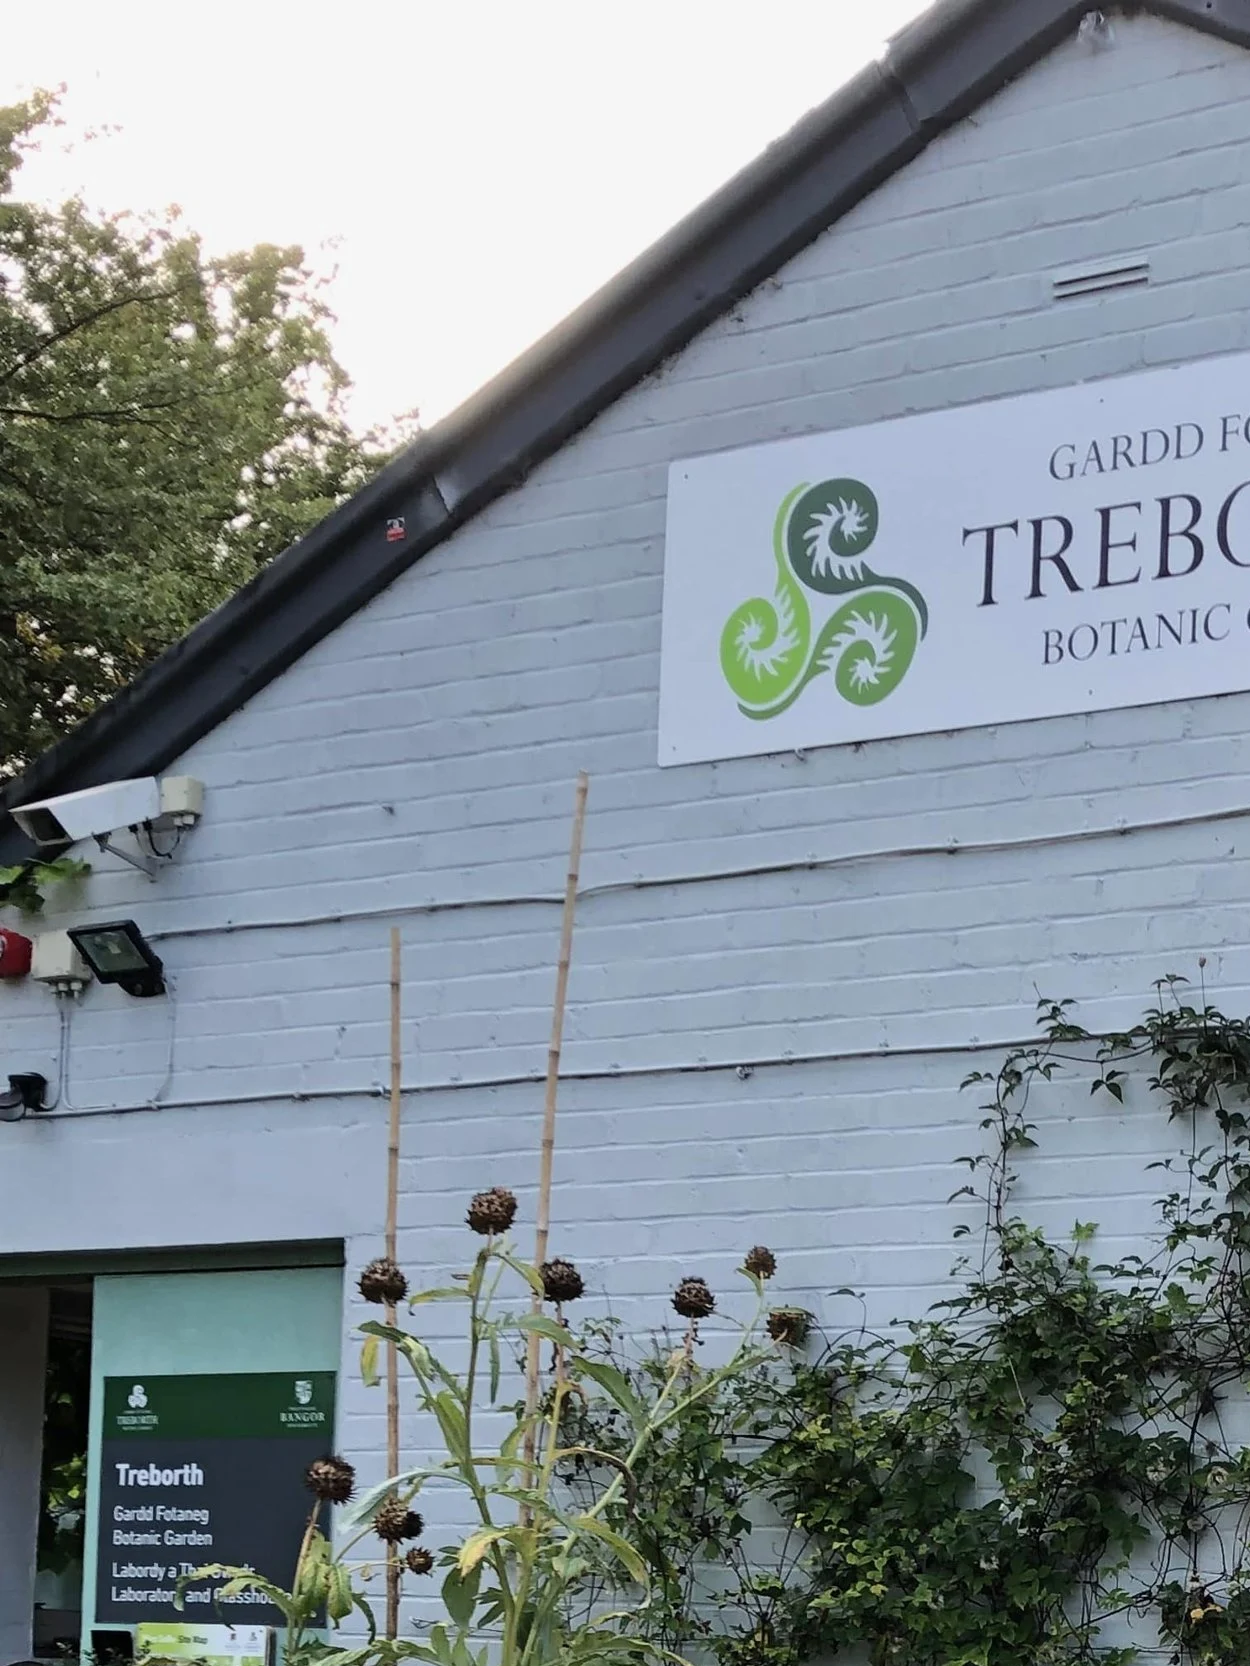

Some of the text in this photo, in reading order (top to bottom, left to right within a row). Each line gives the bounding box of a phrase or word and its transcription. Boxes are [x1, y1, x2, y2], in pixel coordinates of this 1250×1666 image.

[1048, 422, 1206, 481] GARDD
[1041, 603, 1231, 666] BOTANIC
[279, 1412, 325, 1422] BANGOR
[115, 1463, 204, 1486] Treborth
[113, 1505, 209, 1525] Gardd Fotaneg
[112, 1529, 213, 1545] Botanic Garden
[112, 1562, 166, 1581] Labordy
[168, 1566, 177, 1578] a
[111, 1586, 180, 1602] Laborator
[185, 1587, 211, 1603] and
